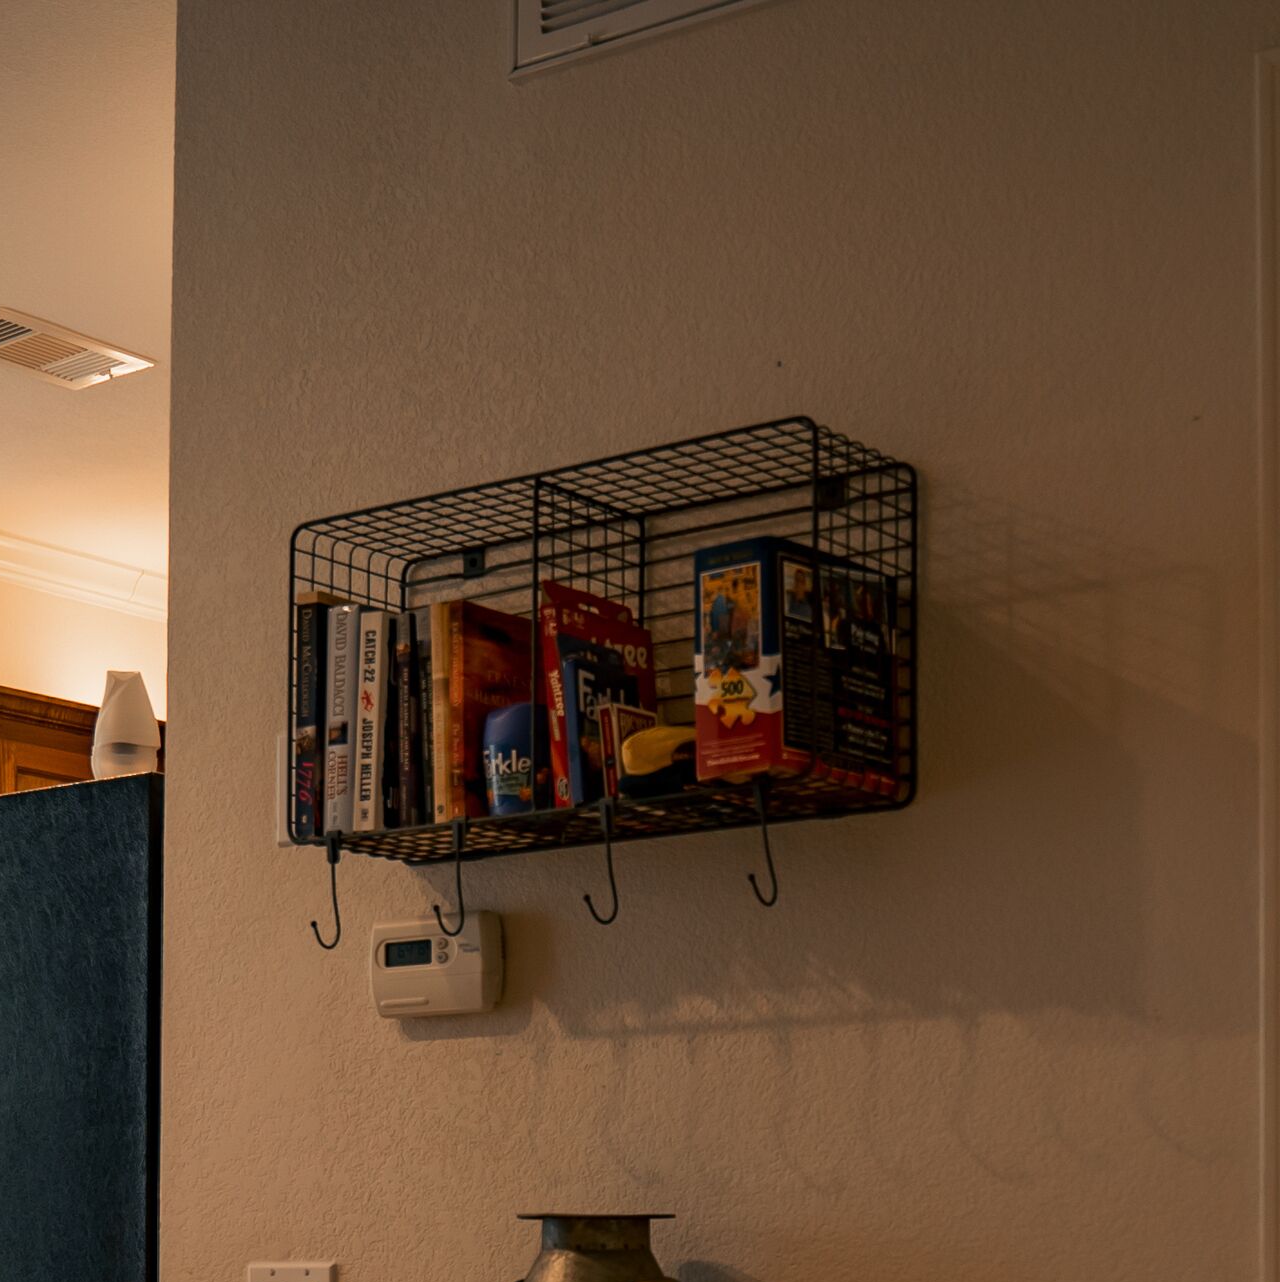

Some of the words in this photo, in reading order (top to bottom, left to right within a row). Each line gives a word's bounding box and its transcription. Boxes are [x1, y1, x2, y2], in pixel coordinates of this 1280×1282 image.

[335, 611, 349, 652] DAVID
[364, 630, 377, 683] CATCH-22
[333, 655, 347, 717] BALDACCI
[548, 669, 565, 718] Yahtzee
[720, 679, 744, 697] 500
[361, 718, 373, 760] JOSEPH
[297, 759, 315, 804] 1776
[327, 750, 338, 801] CORNER
[337, 754, 348, 797] HELL'S
[359, 764, 372, 802] HELLER
[482, 748, 532, 779] Farkle
